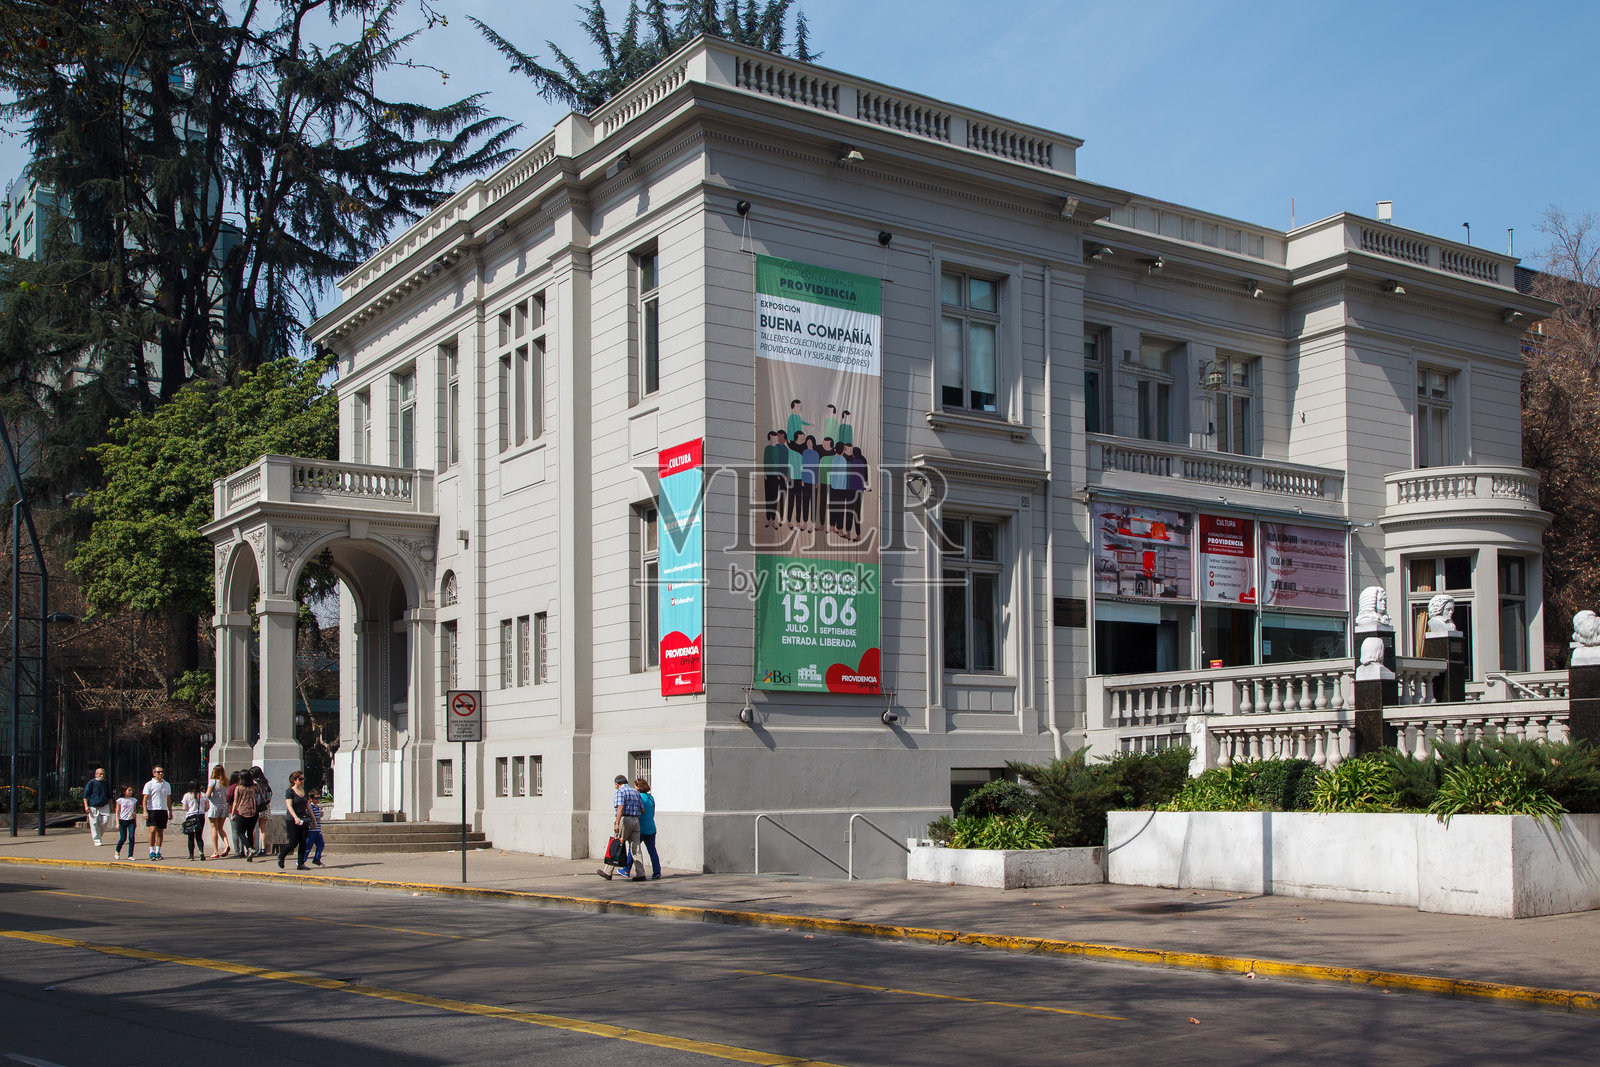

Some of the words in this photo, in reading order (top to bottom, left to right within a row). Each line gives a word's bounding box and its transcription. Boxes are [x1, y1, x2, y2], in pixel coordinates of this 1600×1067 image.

[780, 278, 857, 301] PROVIDENCIA
[760, 300, 800, 314] EXPOSICIÓN
[760, 314, 802, 334] BUENA
[807, 322, 872, 346] COMPAÑÍA
[760, 331, 789, 343] TALLERES
[789, 338, 827, 350] COLECTIVOS
[827, 343, 837, 352] DE
[837, 344, 864, 357] ARTISTAS
[863, 349, 873, 358] EN
[760, 342, 802, 356] PROVIDENCIA
[812, 351, 825, 360] SUS
[824, 353, 870, 369] ALREDEDORES)
[669, 453, 692, 469] CULTURA
[1216, 519, 1236, 527] CULTURA
[1208, 537, 1244, 547] PROVIDENCIA
[781, 569, 811, 580] MARTES
[820, 572, 857, 583] DOMINGO
[821, 582, 857, 596] HORAS
[782, 594, 809, 624] 15
[820, 596, 857, 627] 06
[785, 624, 809, 633] JULIO
[819, 626, 857, 636] SEPTIEMBRE
[781, 635, 817, 646] ENTRADA
[820, 638, 857, 648] LIBERADA
[665, 646, 699, 659] PROVIDENCIA
[773, 670, 791, 684] Bci
[841, 675, 878, 683] PROVIDENCIA
